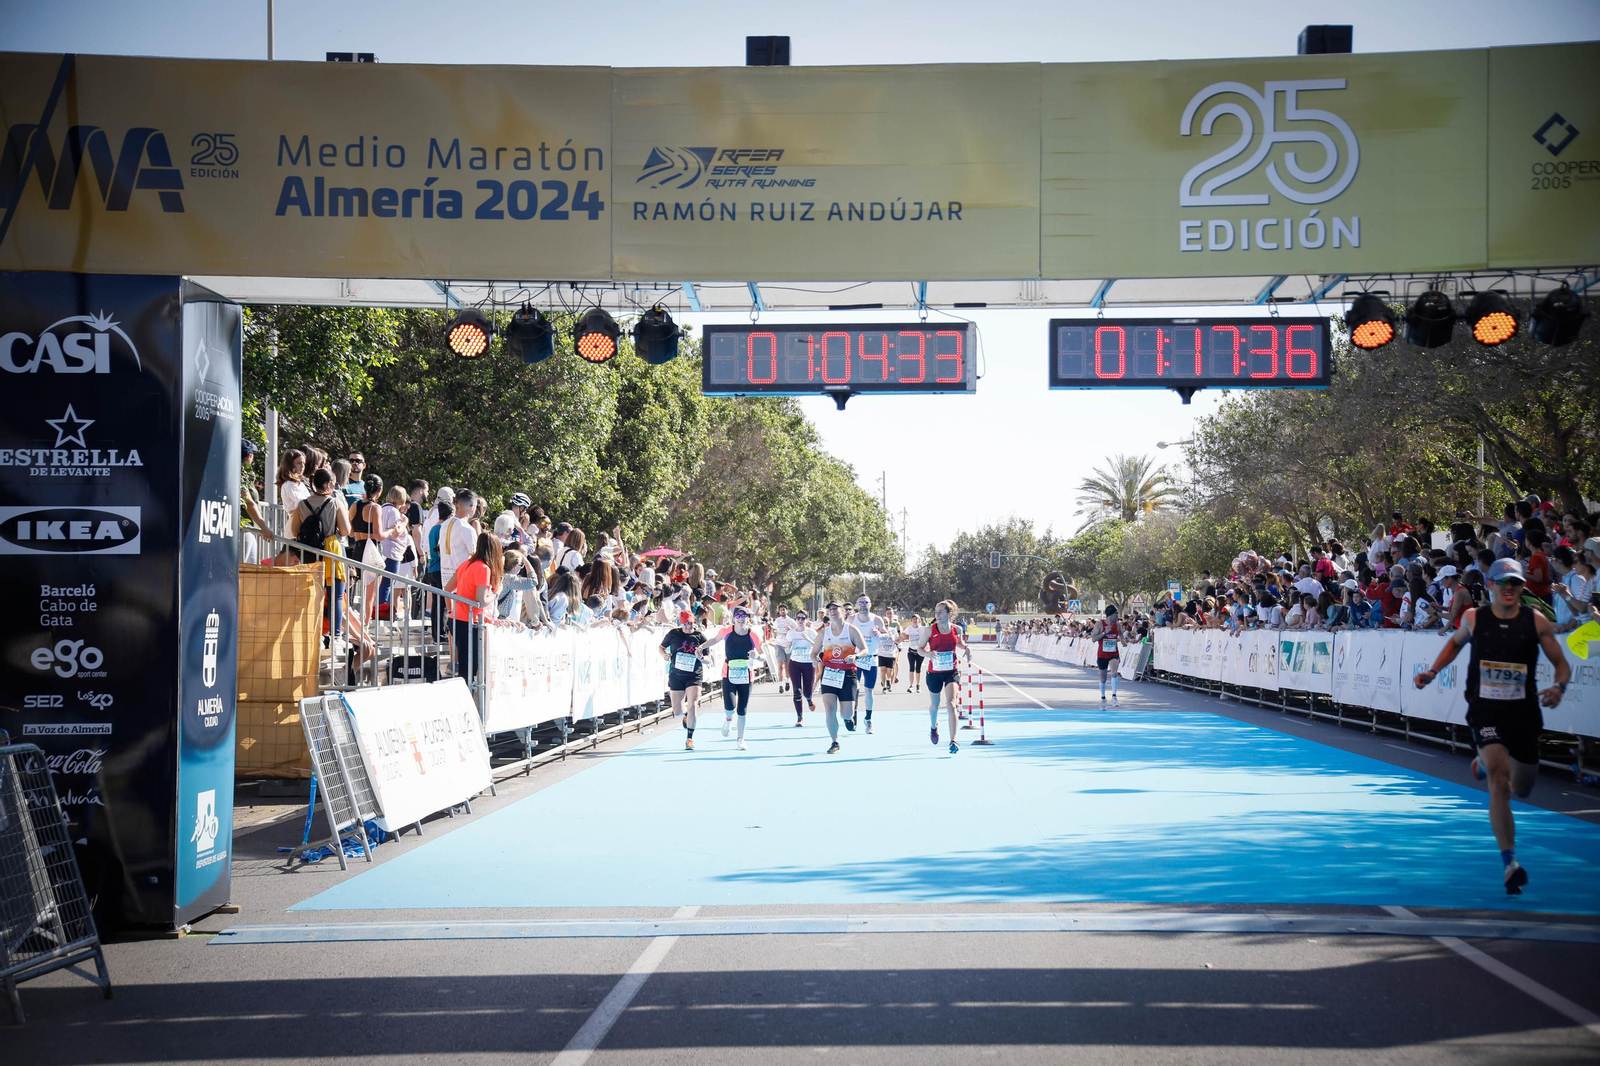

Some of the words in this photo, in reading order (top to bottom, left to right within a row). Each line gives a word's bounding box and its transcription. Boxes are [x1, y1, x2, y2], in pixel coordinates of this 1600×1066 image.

[191, 133, 239, 166] 25
[1180, 78, 1360, 206] 25
[277, 134, 406, 168] Medio
[428, 137, 604, 171] Maratón
[717, 149, 785, 165] RFEA
[190, 167, 239, 179] EDICIÓN
[711, 166, 778, 178] SERIES
[1531, 161, 1600, 175] COOPER
[705, 179, 747, 189] RUTA
[751, 179, 816, 189] RUNNING
[1531, 176, 1571, 190] 2005
[275, 176, 462, 219] Almería
[475, 179, 604, 220] 2024
[633, 196, 736, 221] RAMÓN
[751, 202, 815, 221] RUIZ
[827, 196, 963, 221] ANDÚJAR
[1179, 209, 1361, 252] EDICIÓN
[0, 332, 110, 374] CASI
[195, 388, 234, 413] COOPERACIÓN
[195, 404, 210, 421] 2005
[0, 449, 143, 467] ESTRELLA
[30, 468, 48, 476] DE
[50, 468, 110, 476] LEVANTE
[17, 520, 124, 540] IKEA
[40, 584, 96, 597] Barceló
[40, 599, 76, 612] Cabo
[79, 599, 98, 612] de
[40, 614, 73, 626] Gata
[30, 639, 104, 678] ego
[1485, 668, 1522, 681] 1792
[23, 695, 64, 708] SER
[197, 694, 224, 716] ALMERÍA
[24, 726, 36, 734] La
[38, 726, 56, 734] Voz
[60, 725, 70, 733] de
[71, 724, 110, 733] Almería
[204, 716, 218, 728] CIUDAD
[25, 788, 105, 806] Analucía
